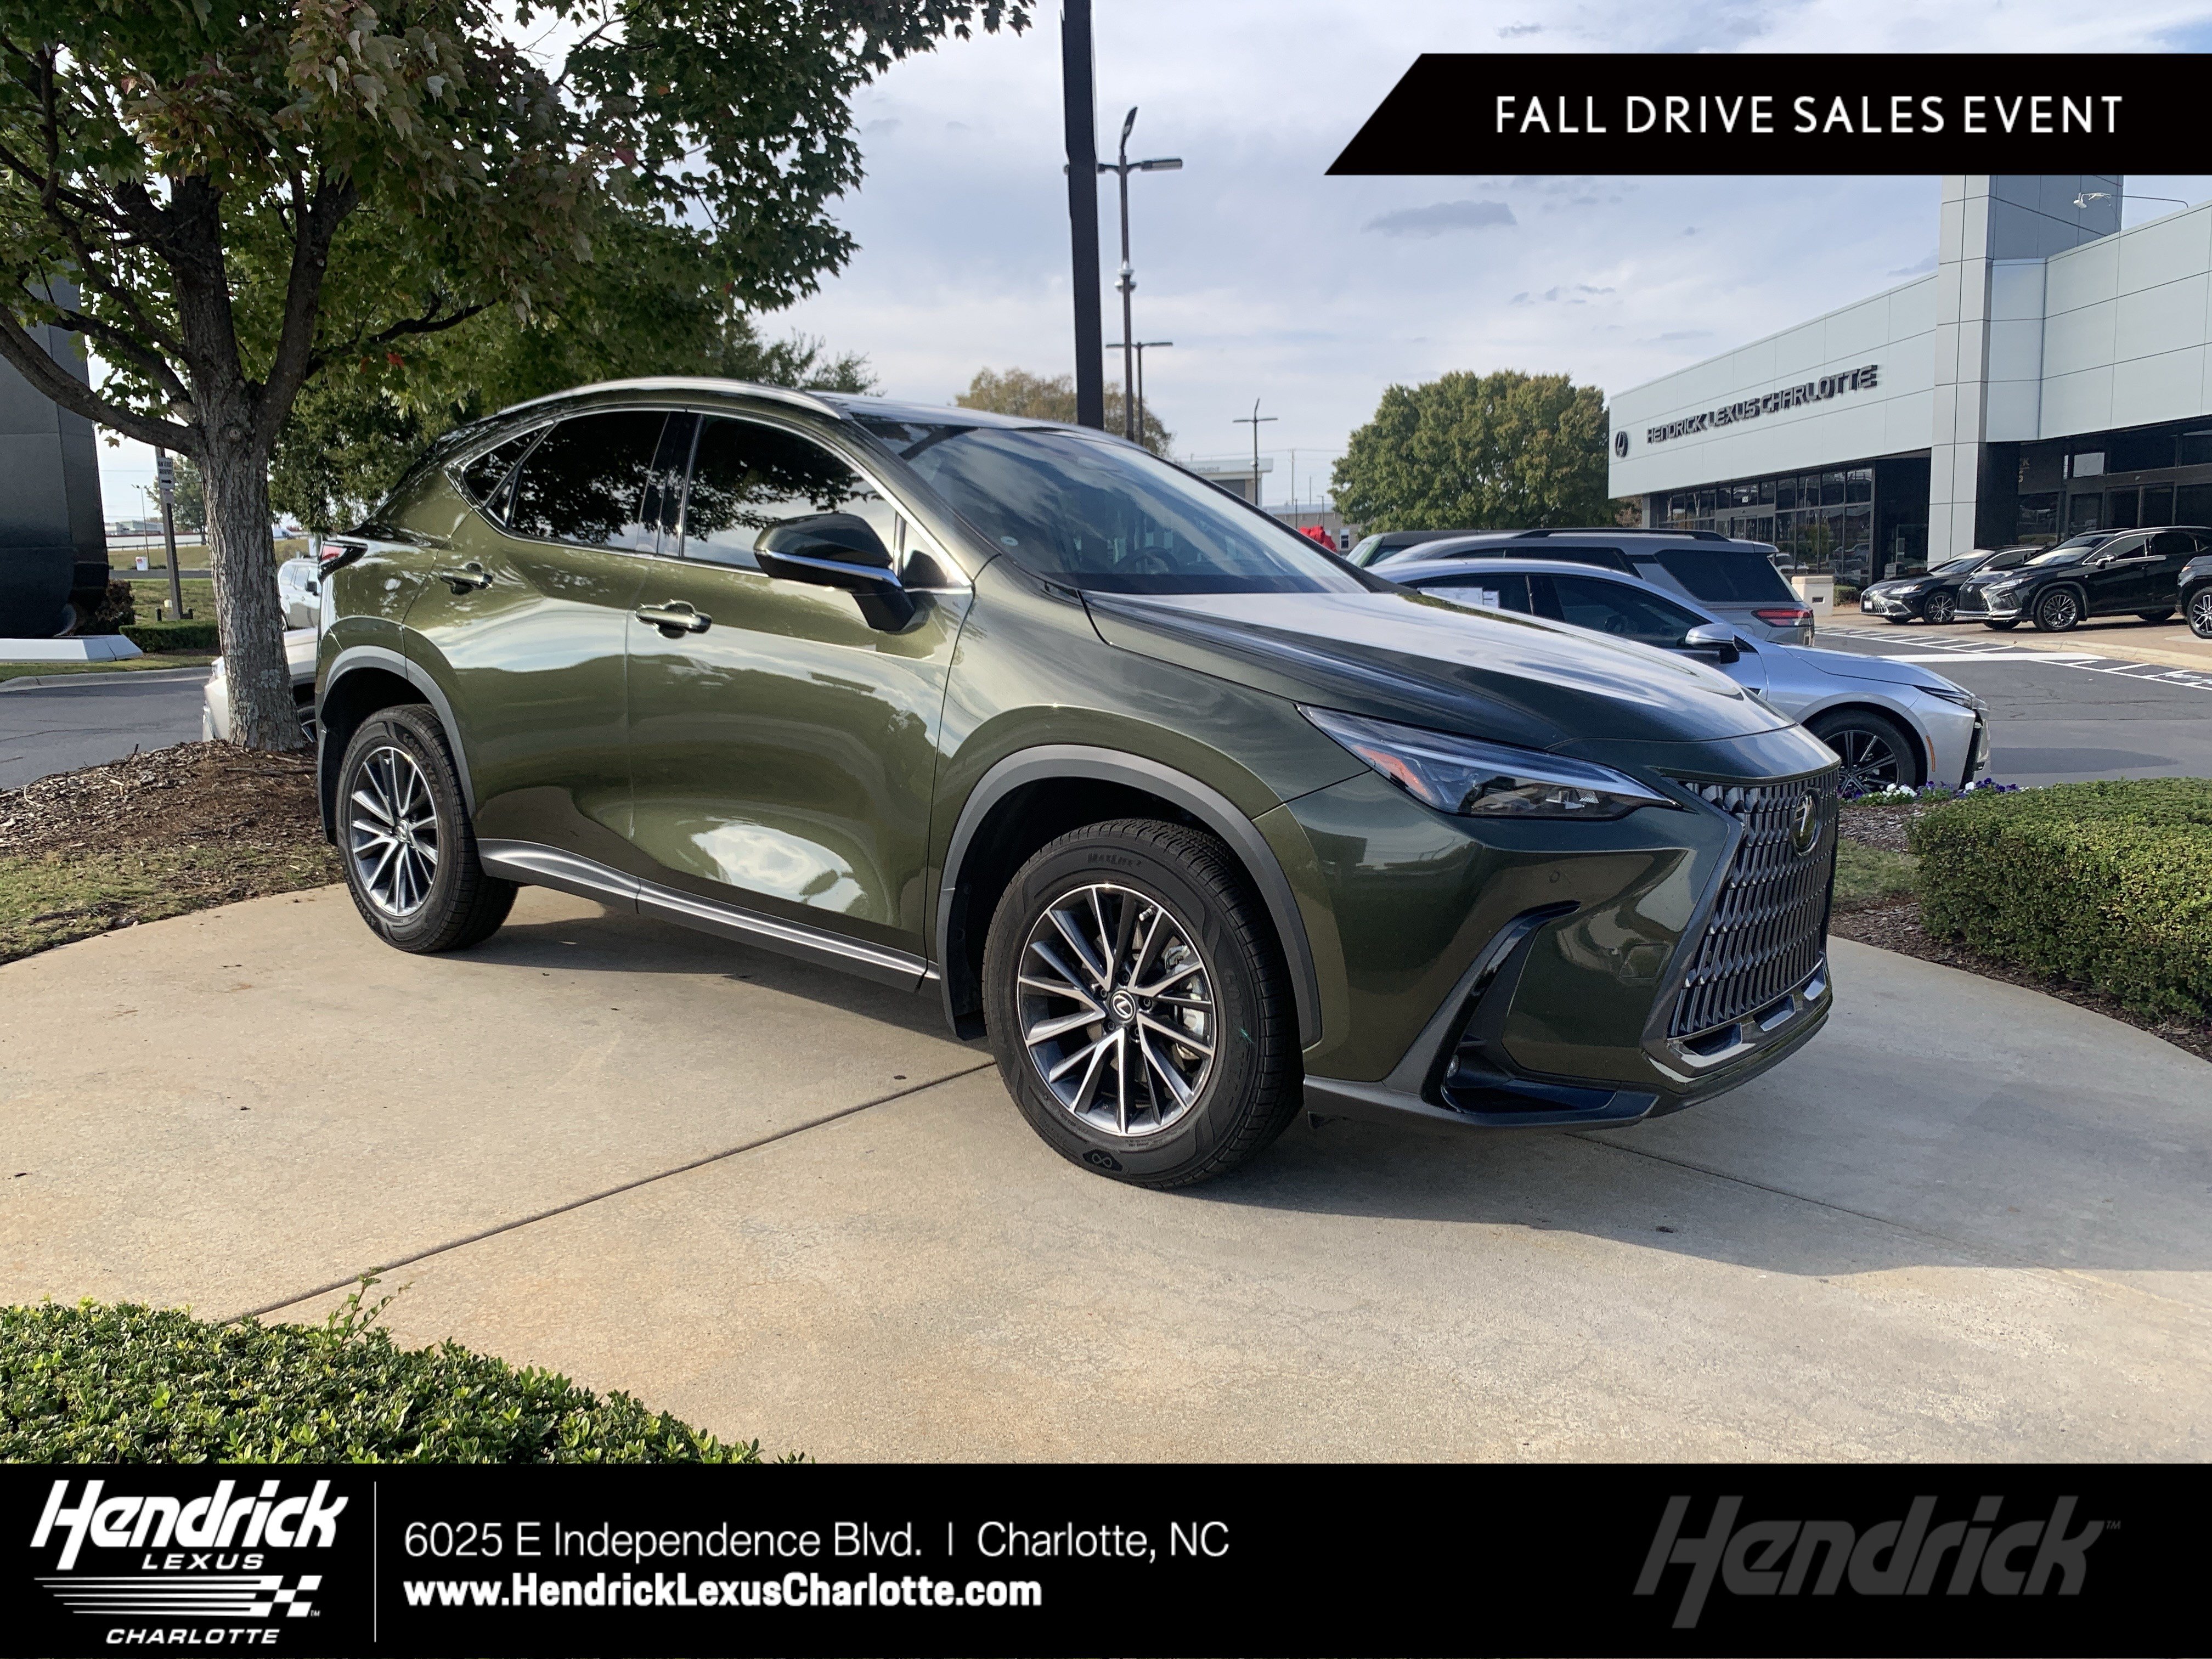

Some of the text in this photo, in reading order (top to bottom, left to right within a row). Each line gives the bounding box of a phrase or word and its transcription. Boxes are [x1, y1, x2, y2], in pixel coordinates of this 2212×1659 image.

[1647, 364, 1878, 444] HENDRICK LEXUS CHARLOTTE
